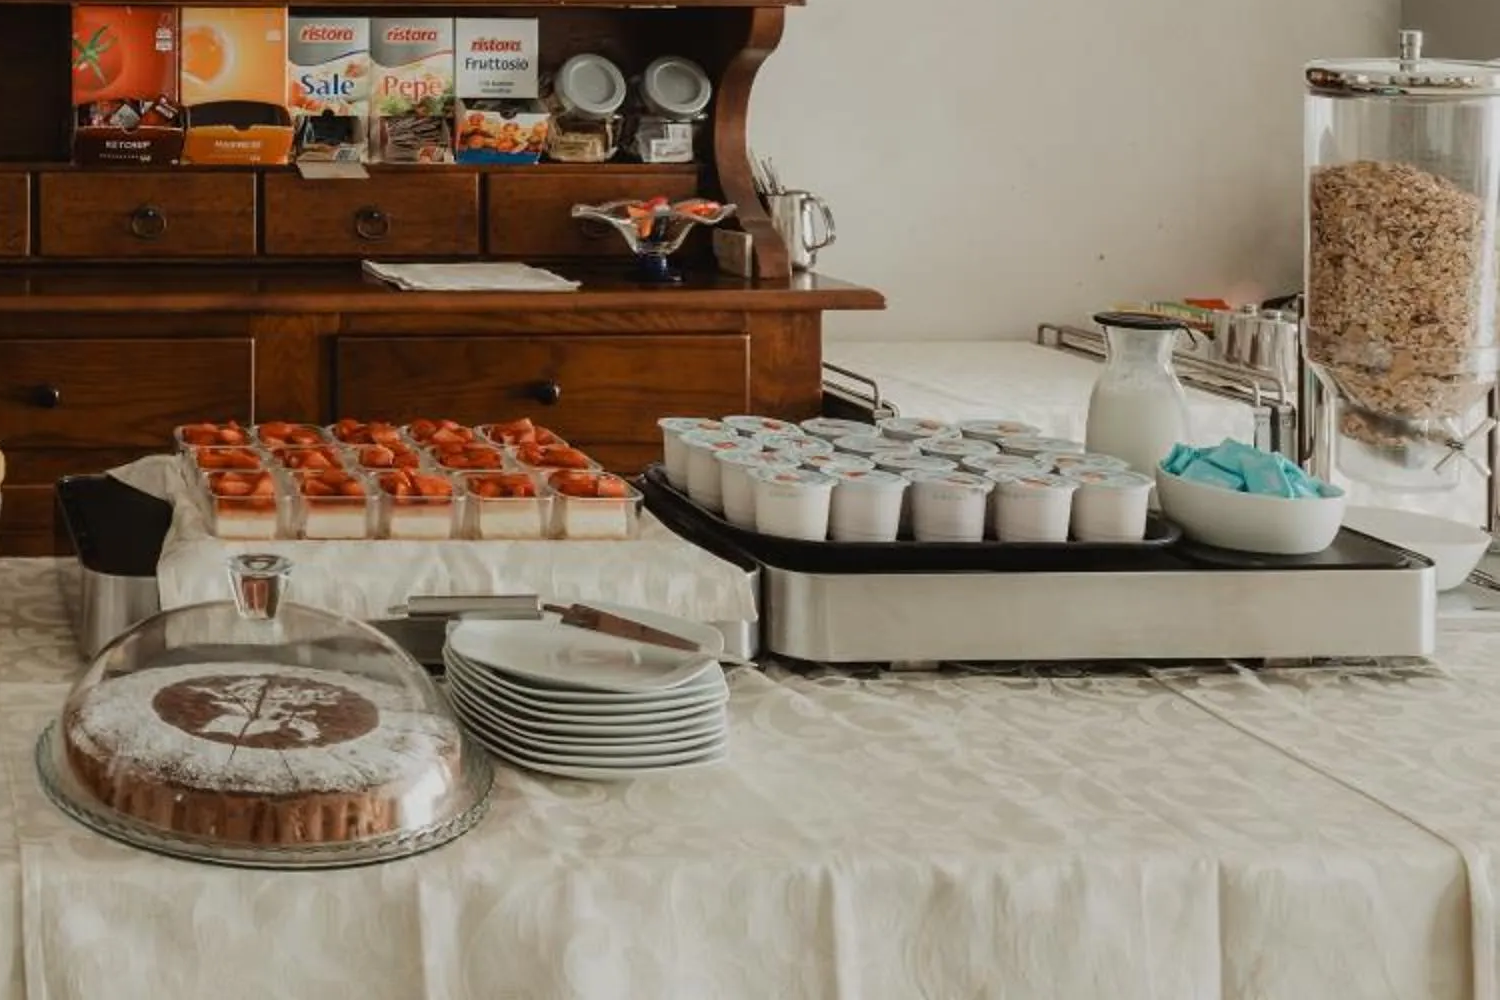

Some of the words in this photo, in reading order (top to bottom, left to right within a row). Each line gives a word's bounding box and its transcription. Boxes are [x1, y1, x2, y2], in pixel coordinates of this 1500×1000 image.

[301, 27, 354, 41] ristora
[386, 27, 438, 41] ristora
[471, 37, 523, 53] ristora
[464, 57, 530, 71] Fruttosio
[301, 73, 355, 95] Sale
[383, 74, 444, 102] Pepe
